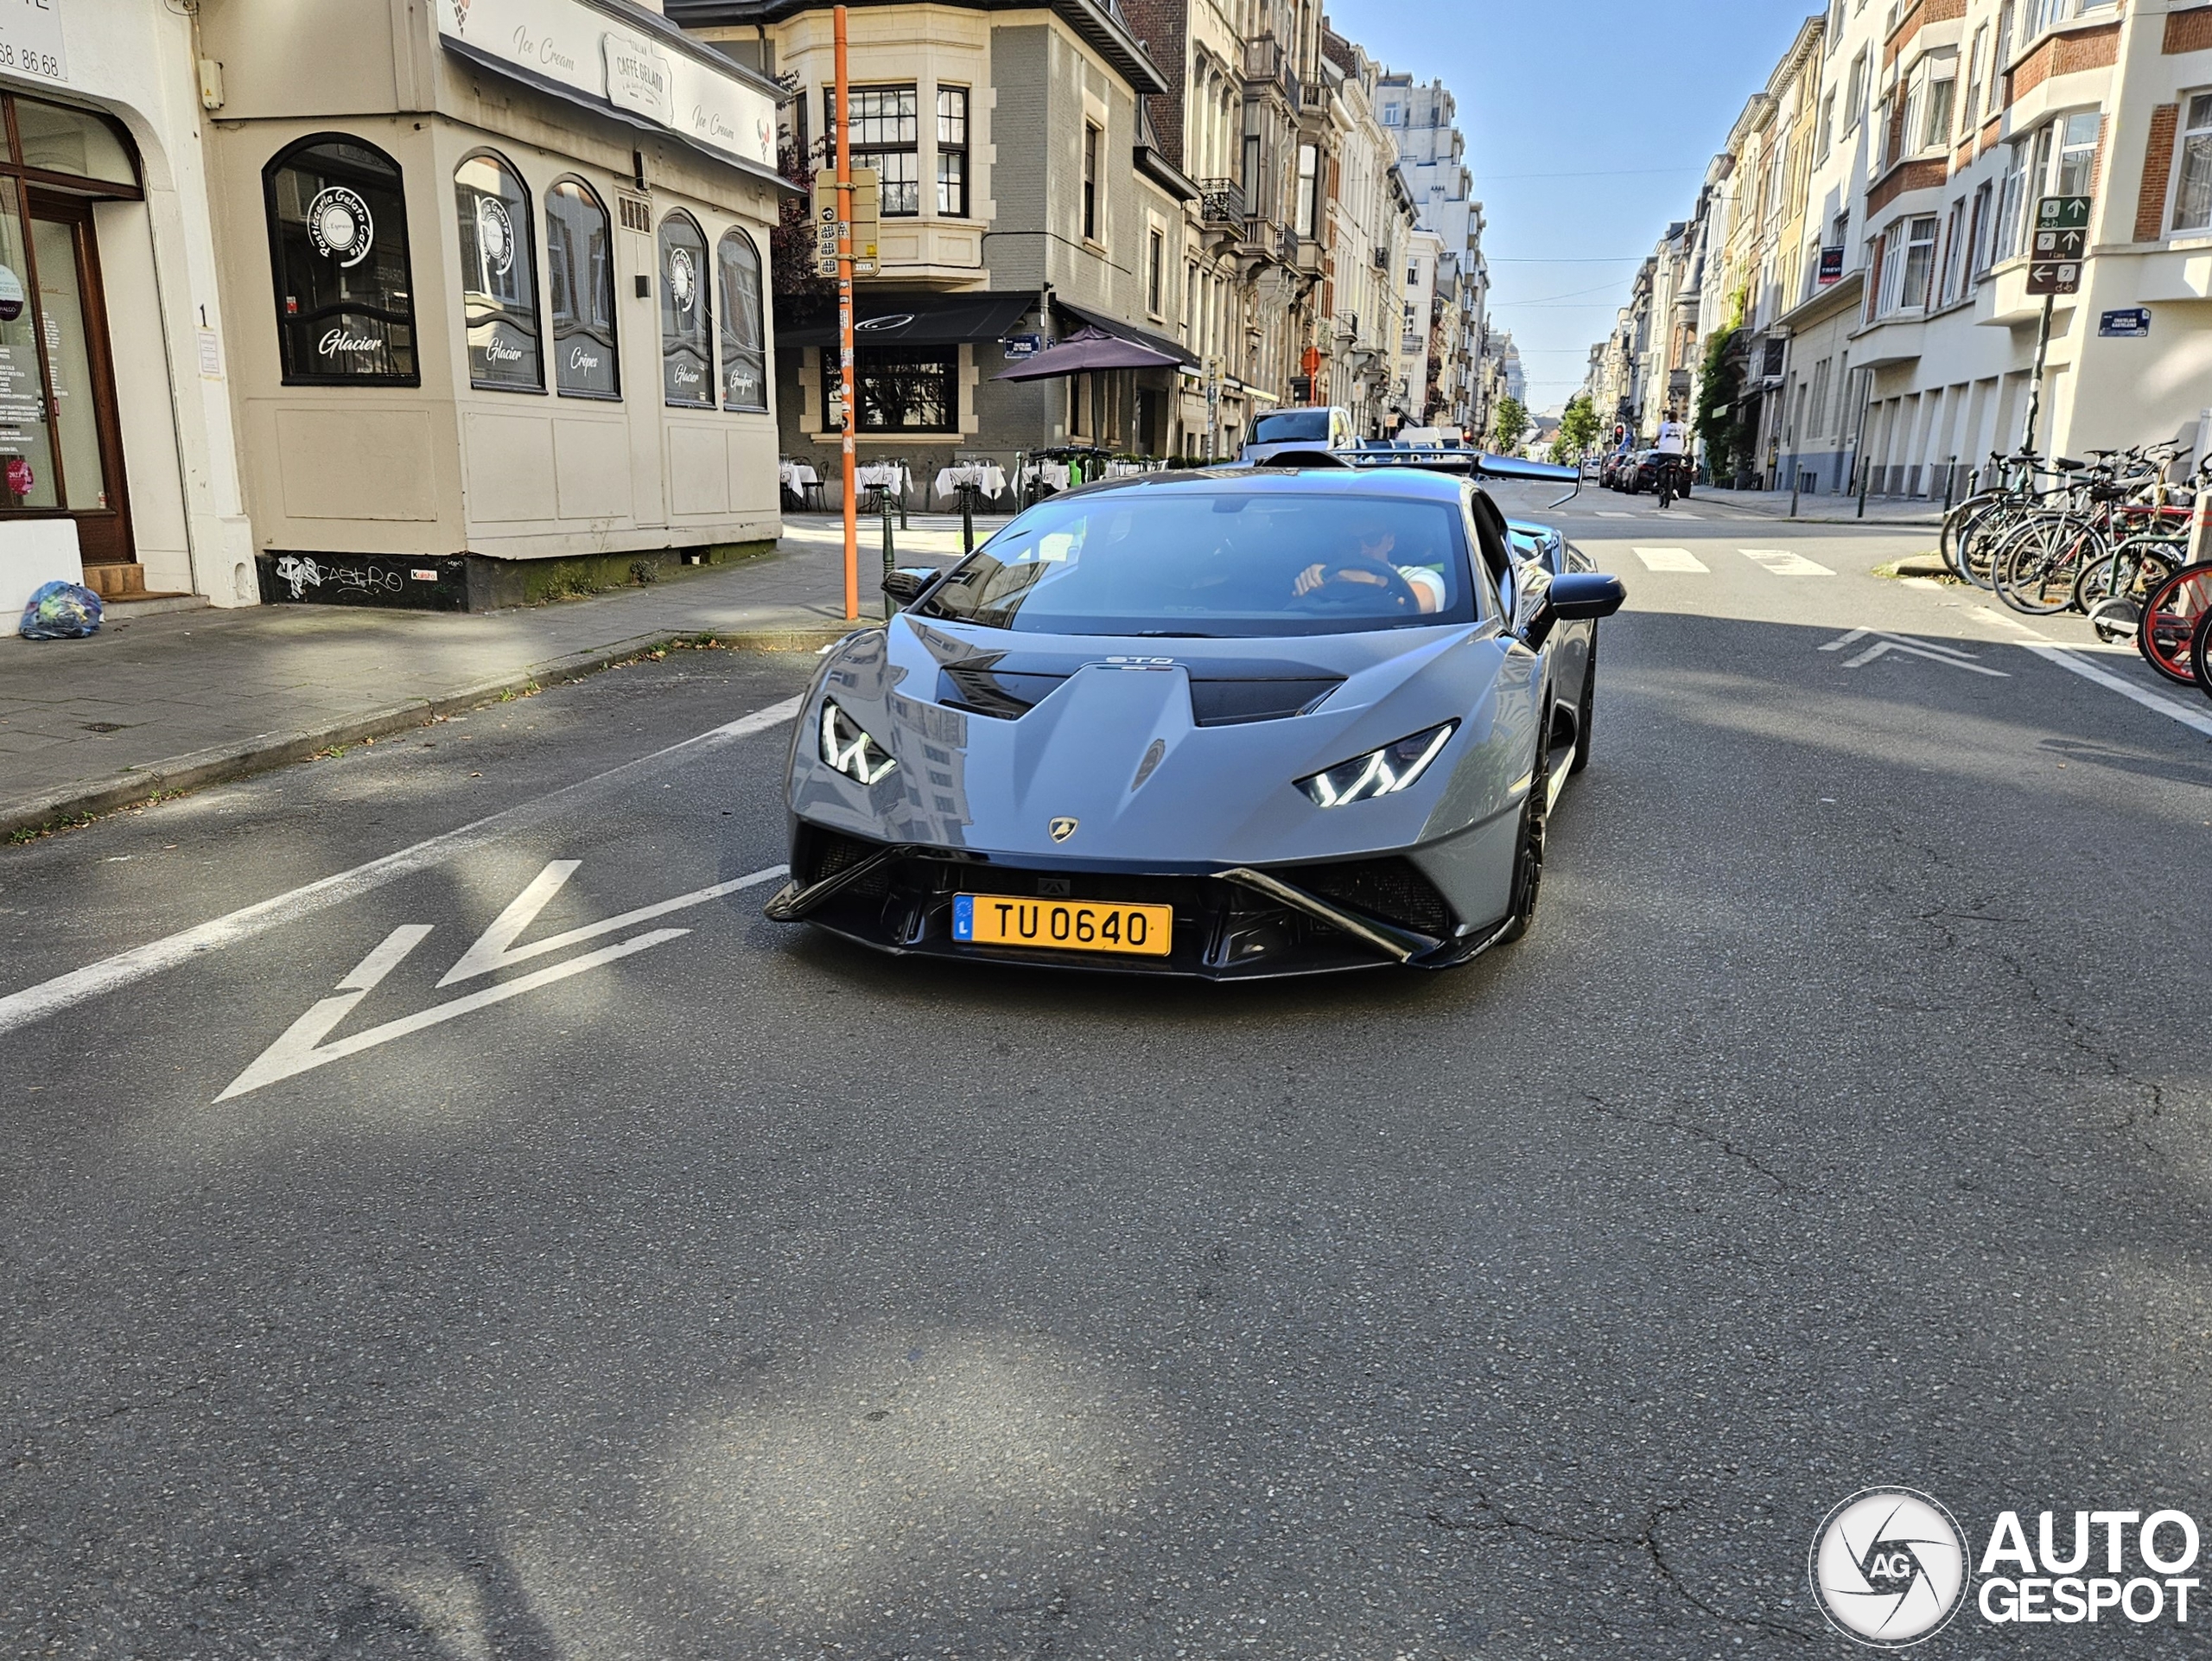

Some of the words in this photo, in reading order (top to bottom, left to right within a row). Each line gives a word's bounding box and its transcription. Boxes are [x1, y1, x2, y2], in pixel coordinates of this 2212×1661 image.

[513, 25, 534, 54] Ice
[540, 37, 575, 71] Cream
[22, 49, 39, 72] 86
[42, 54, 59, 77] 68
[639, 62, 664, 93] GELATO
[692, 105, 706, 130] Ice
[710, 113, 734, 140] Cream
[2048, 205, 2054, 213] 6
[311, 195, 334, 258] Pasticceria
[335, 190, 365, 222] Gelato
[821, 225, 835, 233] JAZZ
[2044, 237, 2050, 245] 7
[2063, 269, 2069, 277] 7
[200, 303, 207, 328] 1
[318, 328, 383, 359] Glacier
[486, 337, 522, 366] Glacier
[570, 347, 599, 376] Crêpes
[675, 364, 699, 387] Glacier
[316, 565, 404, 593] CASTRO
[1106, 655, 1174, 665] STO
[959, 921, 969, 934] L
[995, 904, 1039, 939] TU
[1051, 907, 1147, 946] 0640
